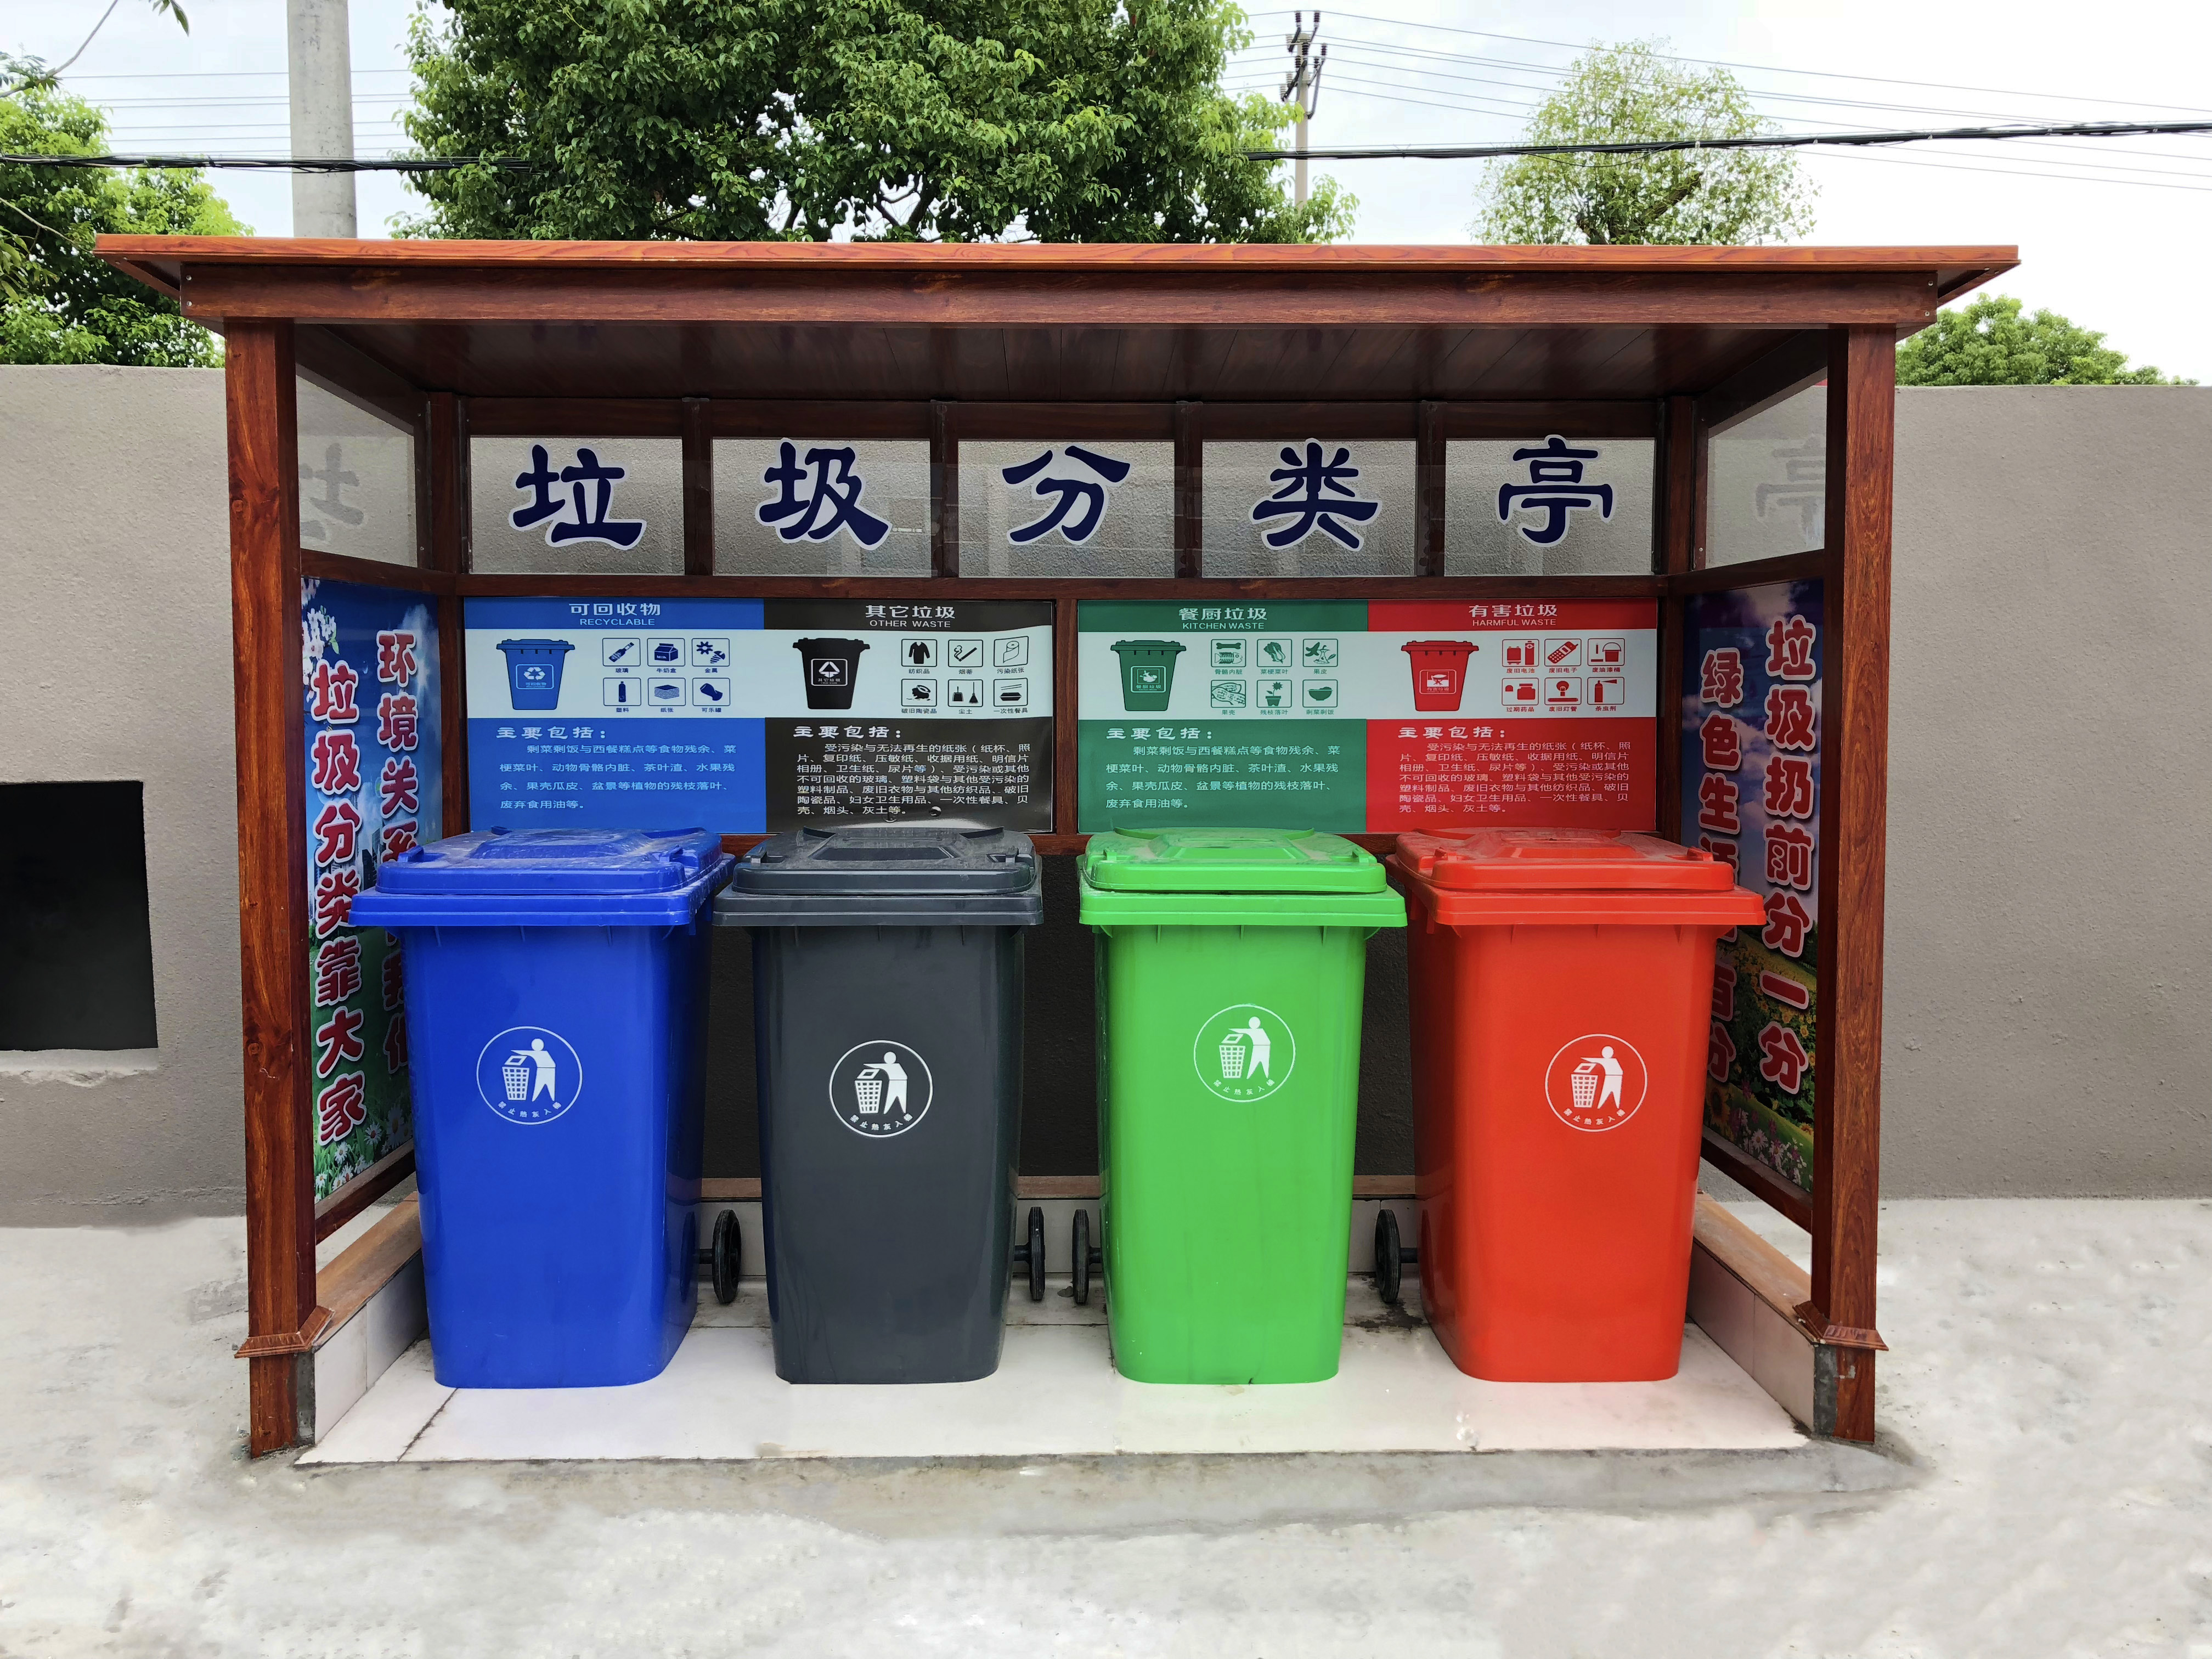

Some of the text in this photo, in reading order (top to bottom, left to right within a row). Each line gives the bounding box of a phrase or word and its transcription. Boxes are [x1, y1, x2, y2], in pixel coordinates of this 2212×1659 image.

[509, 435, 1615, 550] 垃圾分类亭
[569, 603, 660, 616] 可回收物
[866, 605, 955, 618] 其它垃圾
[1179, 608, 1267, 620] 餐厨垃圾
[1469, 605, 1557, 617] 有害垃圾
[496, 726, 605, 740] 主要包括：
[793, 726, 900, 738] 主要包括：
[1107, 727, 1211, 740] 主要包括：
[1398, 726, 1504, 739] 主要包括：
[1106, 799, 1187, 808] 废弃食用油等。
[1758, 614, 1816, 1095] 垃圾扔前分一分
[311, 659, 366, 1147] 垃圾分类靠大家
